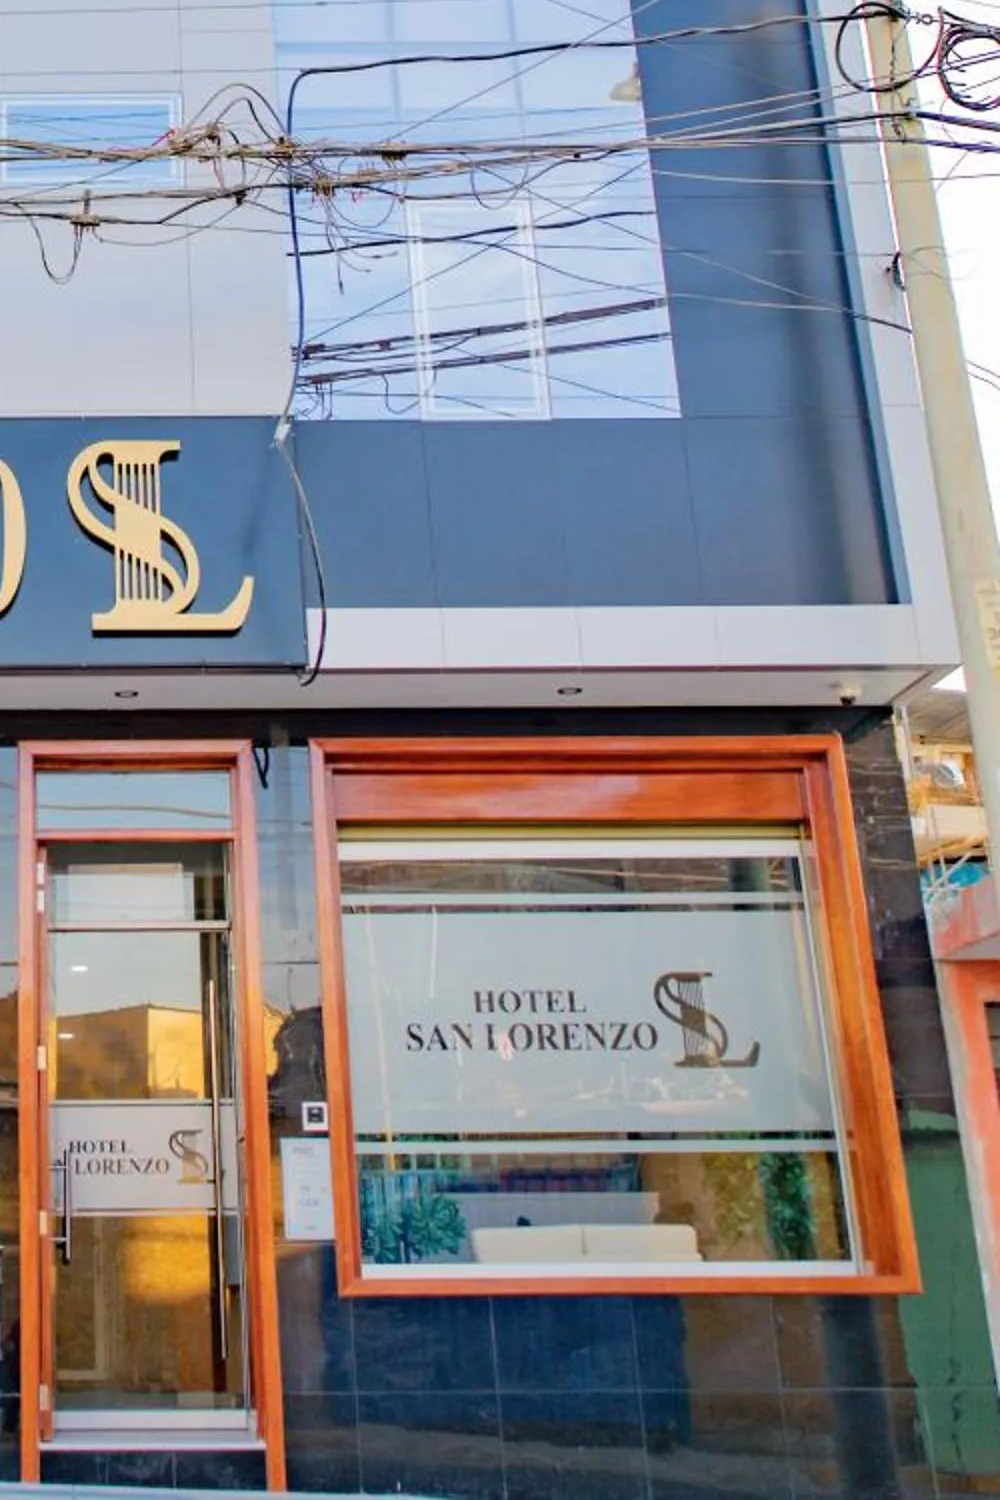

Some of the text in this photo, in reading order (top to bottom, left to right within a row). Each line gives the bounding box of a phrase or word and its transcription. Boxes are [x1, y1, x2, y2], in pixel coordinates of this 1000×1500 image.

[473, 990, 587, 1014] HOTEL
[406, 1022, 472, 1052] SAN
[486, 1022, 659, 1052] LORENZO
[69, 1139, 133, 1154] HOTEL
[74, 1158, 170, 1175] LORENZO
